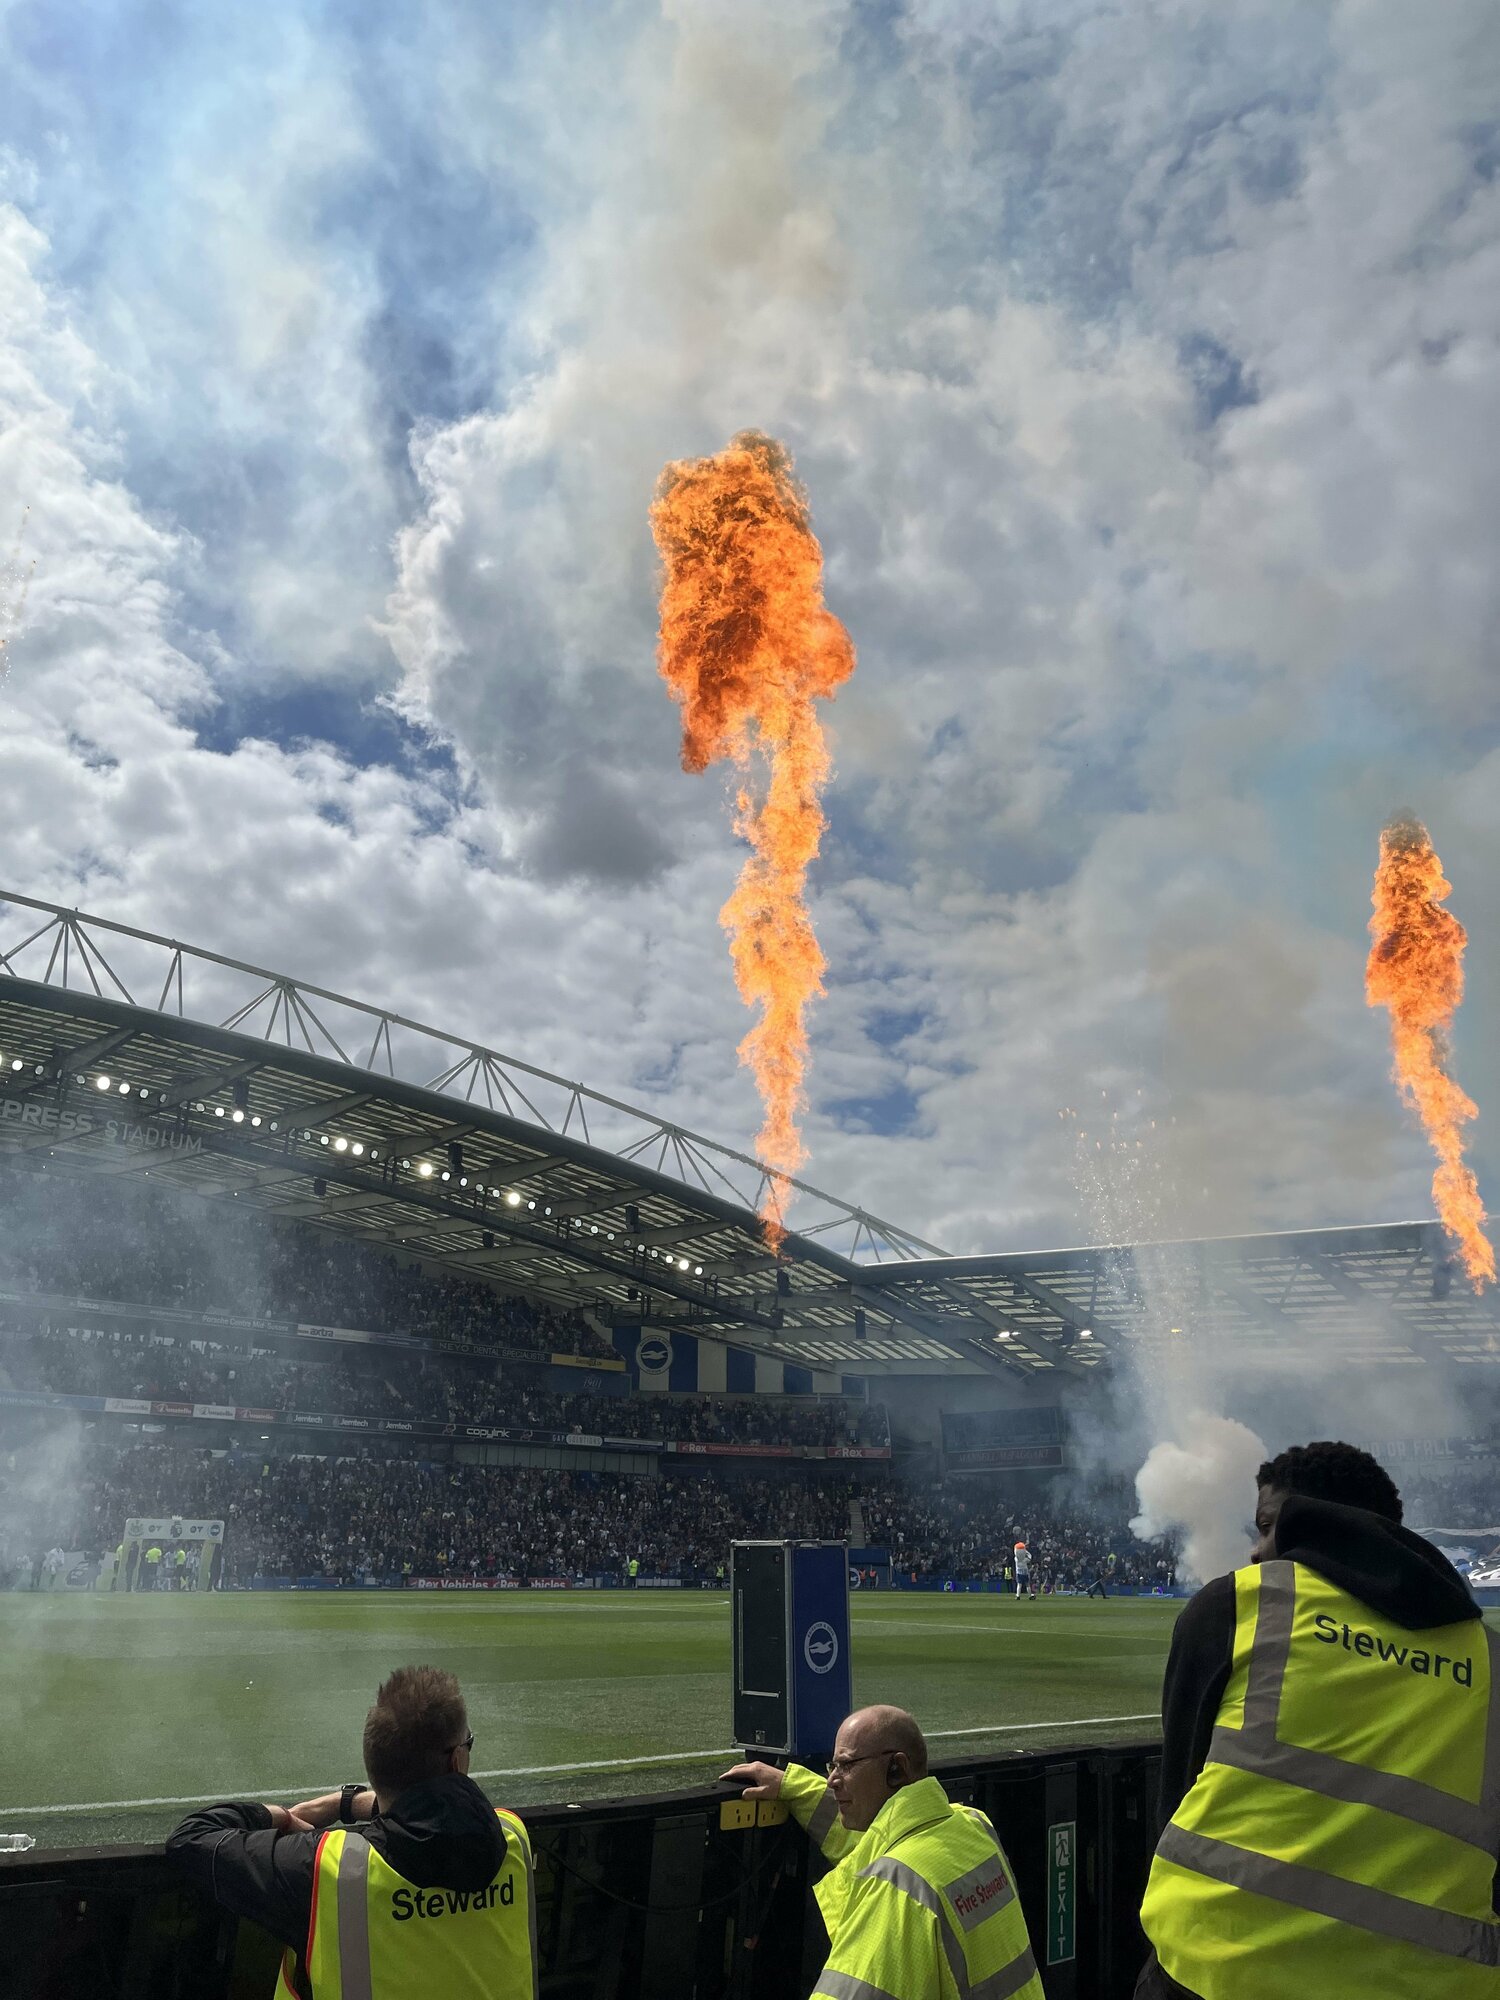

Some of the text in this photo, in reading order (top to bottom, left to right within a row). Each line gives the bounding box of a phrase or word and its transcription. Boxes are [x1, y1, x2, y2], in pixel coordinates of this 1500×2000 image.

[104, 1120, 203, 1153] STADIUM
[473, 1346, 500, 1356] DENTAL
[502, 1349, 545, 1361] SPECIALISTS
[689, 1444, 707, 1454] Rex
[842, 1447, 862, 1457] Rex
[418, 1579, 489, 1588] Rex Vehicles
[500, 1579, 520, 1588] Rex
[1313, 1614, 1472, 1688] Steward
[391, 1874, 514, 1921] Steward
[954, 1867, 1009, 1917] Fire Steward
[1057, 1871, 1066, 1956] EXIT
